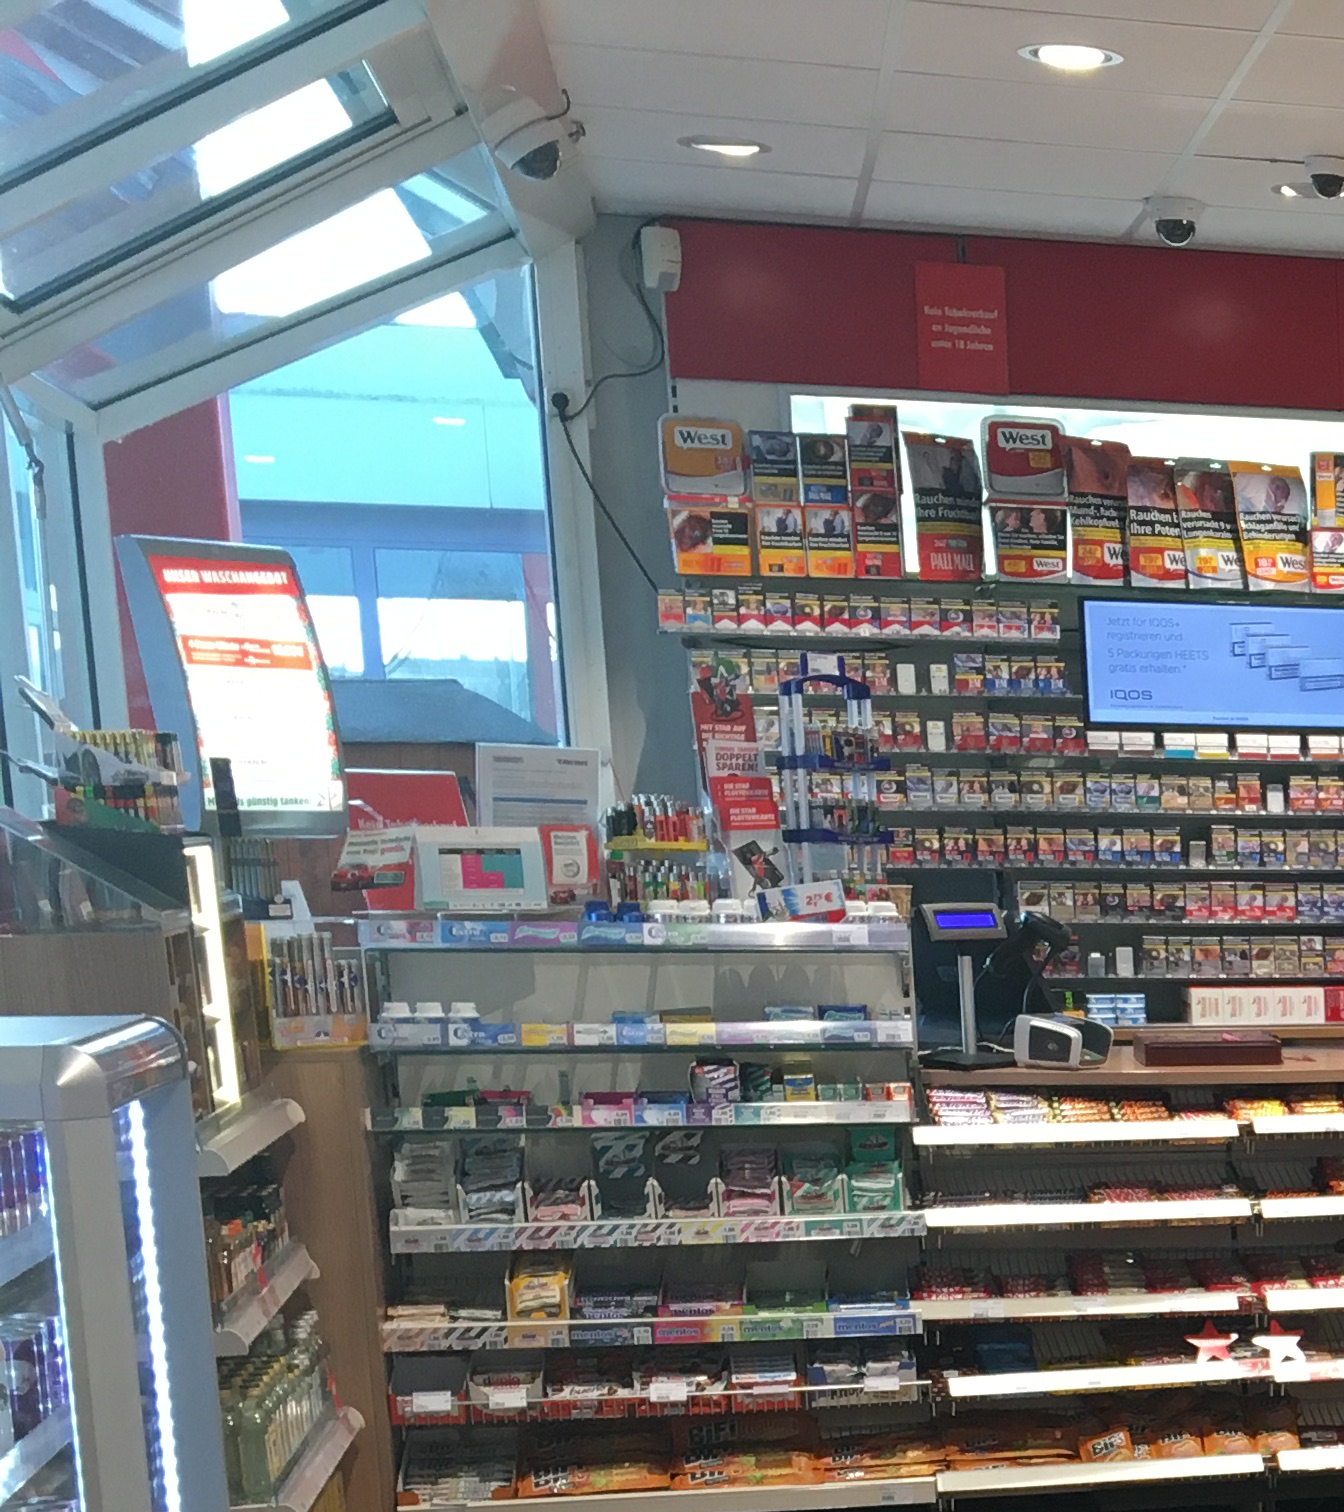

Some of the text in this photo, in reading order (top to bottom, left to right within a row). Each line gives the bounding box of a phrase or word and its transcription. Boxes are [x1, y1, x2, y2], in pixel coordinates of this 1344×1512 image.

[678, 430, 727, 446] West
[1001, 431, 1047, 446] West
[1130, 510, 1167, 522] Rauchen
[1130, 523, 1152, 534] Ihre
[930, 553, 953, 570] PALL
[1035, 560, 1059, 568] West
[163, 569, 288, 585] UNSER WASCHANGEBOT
[1106, 617, 1130, 627] Jetzt
[1132, 617, 1147, 627] für
[1107, 631, 1183, 643] registrieren und
[1108, 649, 1209, 661] 5 Packungen HEETS
[1109, 663, 1137, 674] gratis
[1110, 689, 1152, 700] IQOS
[715, 752, 759, 762] DOPPELT
[716, 762, 758, 772] SPAREN!
[658, 1326, 700, 1338] mentos
